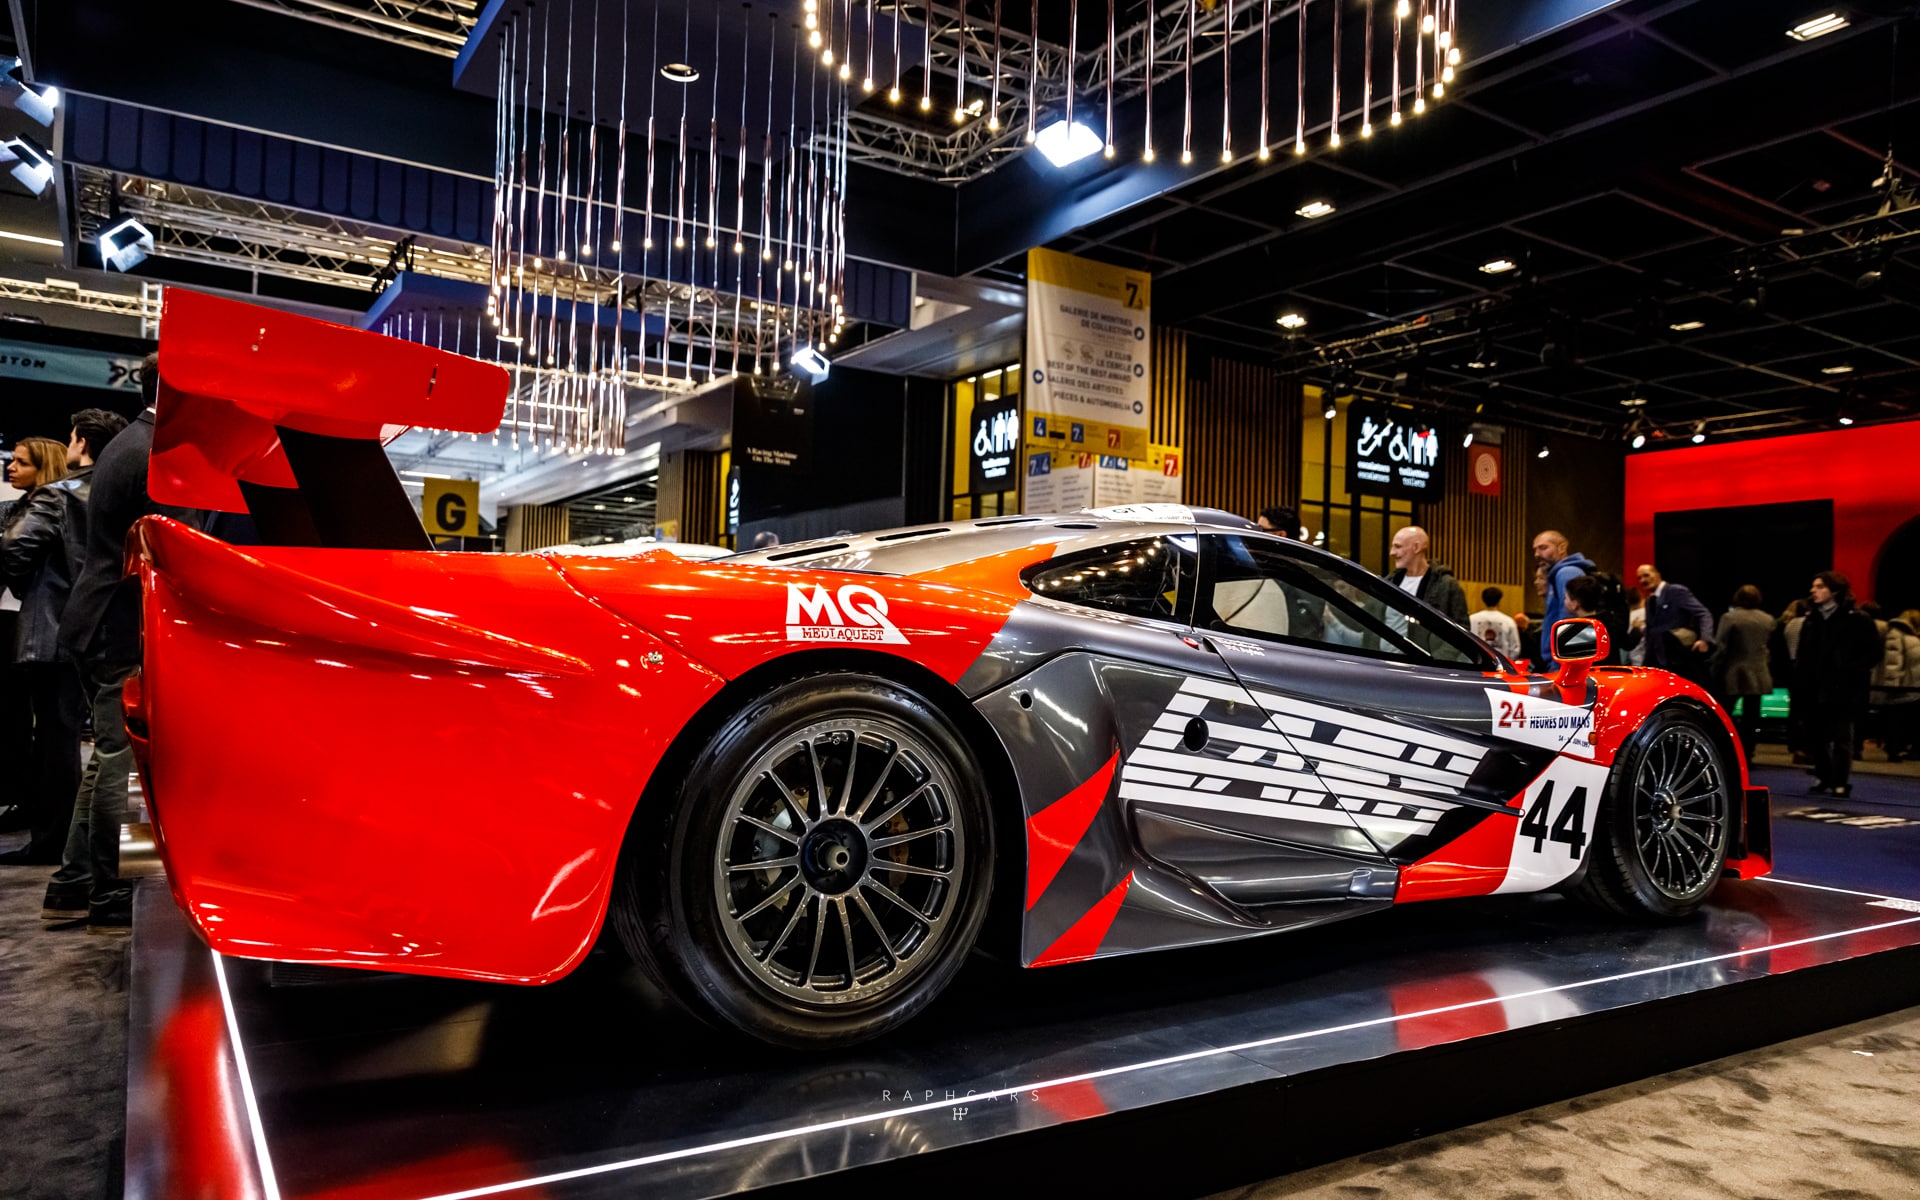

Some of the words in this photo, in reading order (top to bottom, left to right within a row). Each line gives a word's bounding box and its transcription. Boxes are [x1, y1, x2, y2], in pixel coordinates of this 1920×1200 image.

[1060, 304, 1089, 318] GALERIE
[1090, 311, 1099, 320] DE
[1100, 313, 1133, 327] MONTRES
[1081, 319, 1090, 329] DE
[1091, 321, 1132, 336] COLLECTION
[1096, 359, 1105, 367] LE
[1106, 361, 1132, 372] CERCLE
[1105, 349, 1113, 358] LE
[1114, 351, 1132, 362] CLUB
[1047, 359, 1065, 370] BEST
[1065, 362, 1074, 371] OF
[1076, 364, 1089, 374] THE
[1090, 367, 1108, 377] BEST
[1108, 371, 1132, 382] AWARD
[1047, 374, 1076, 386] GALERIE
[1077, 379, 1091, 388] DES
[1092, 382, 1124, 395] ARTISTES
[1086, 396, 1131, 410] AUTOMOBILIA
[752, 447, 773, 458] Racing
[436, 491, 467, 532] G
[786, 581, 898, 628] MQ
[802, 627, 884, 642] MEDIAQUEST
[1498, 700, 1527, 729] 24
[1529, 715, 1557, 729] HEURES
[1558, 716, 1570, 729] DU
[1570, 716, 1591, 729] MANS
[1519, 779, 1588, 860] 44
